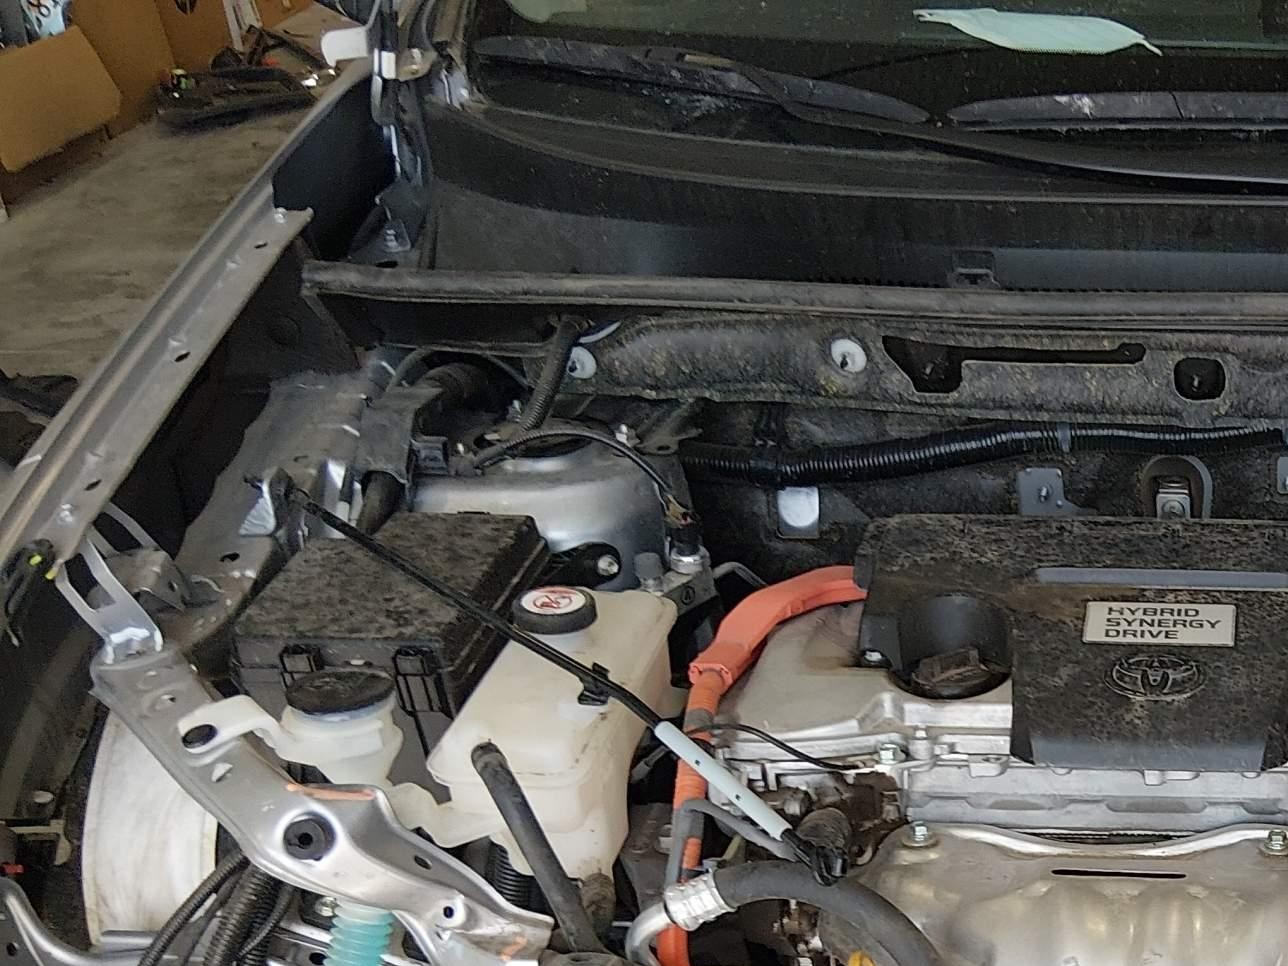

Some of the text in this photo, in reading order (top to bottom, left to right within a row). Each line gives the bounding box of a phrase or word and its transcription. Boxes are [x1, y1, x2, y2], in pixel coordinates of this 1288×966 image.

[1107, 606, 1200, 617] HYBRID
[1105, 617, 1221, 629] SYNERGY
[1104, 628, 1180, 640] DRIVE
